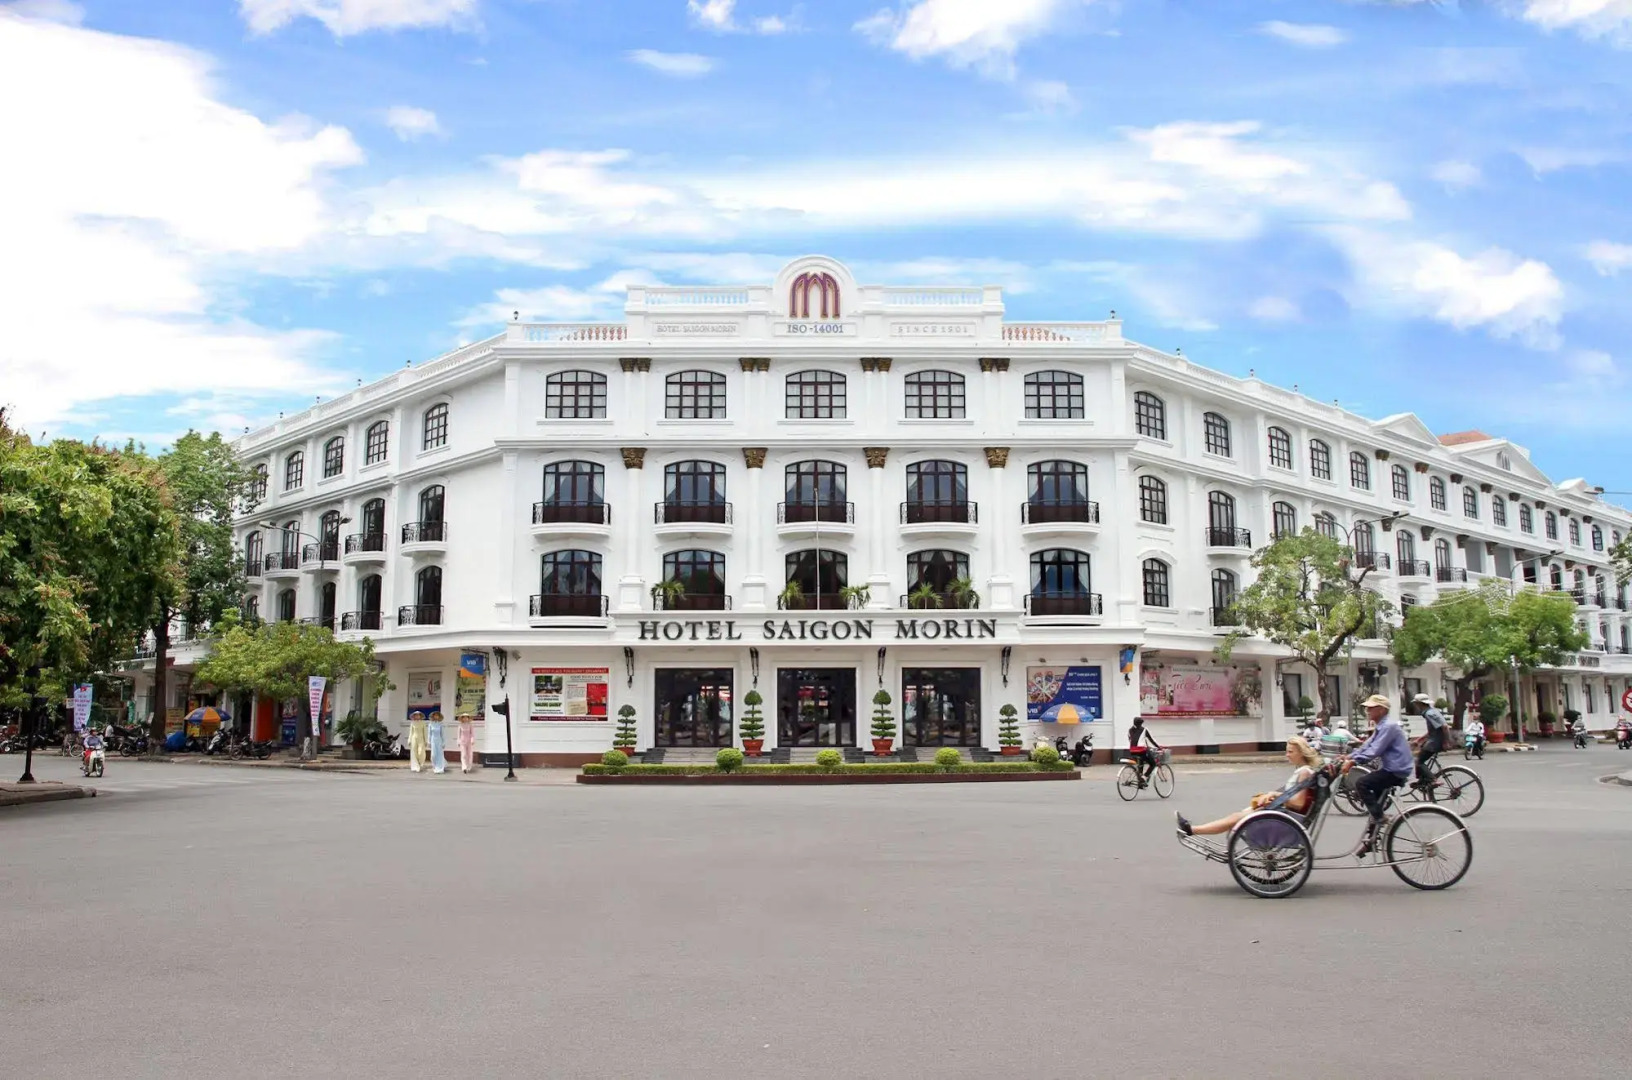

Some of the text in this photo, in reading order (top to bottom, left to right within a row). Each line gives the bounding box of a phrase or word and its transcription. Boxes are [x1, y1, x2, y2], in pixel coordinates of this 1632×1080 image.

[787, 324, 807, 334] ISO
[898, 325, 937, 334] SINCE
[638, 619, 997, 641] HOTEL SAIGON MORIN
